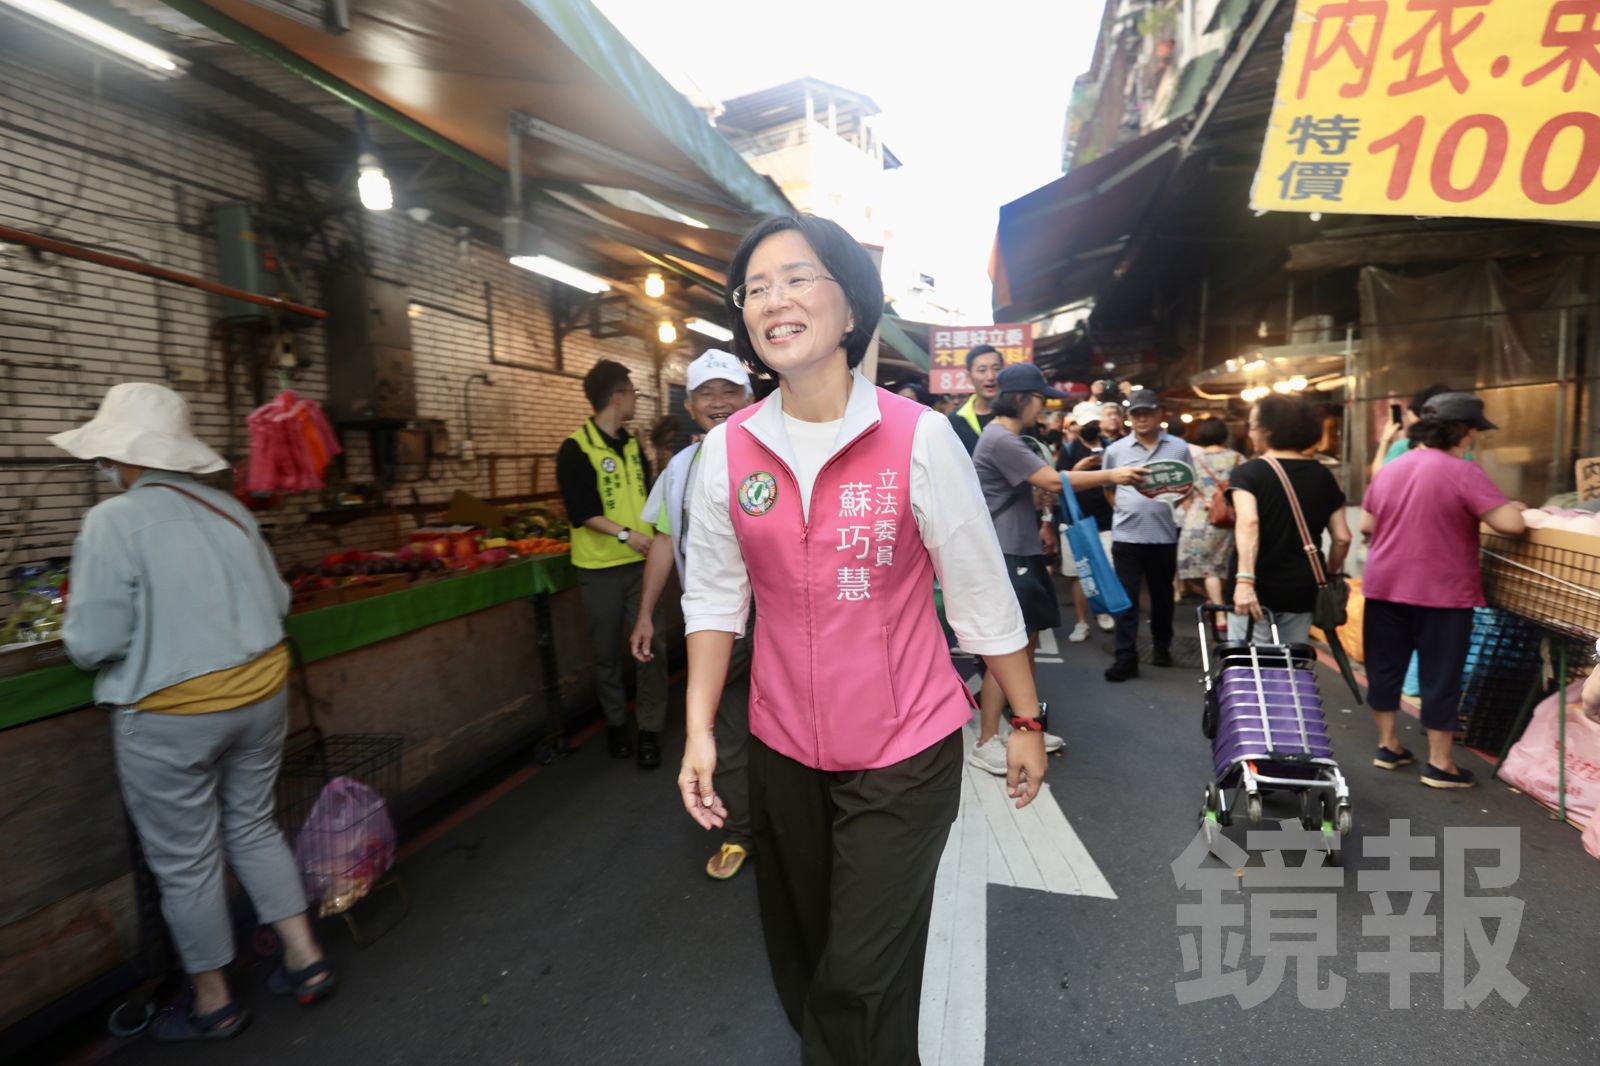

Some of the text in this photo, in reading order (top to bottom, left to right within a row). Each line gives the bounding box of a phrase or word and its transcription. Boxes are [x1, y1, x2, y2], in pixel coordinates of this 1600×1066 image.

[1277, 114, 1360, 202] 特價
[1367, 111, 1600, 205] 100
[935, 329, 1023, 348] 只要好立委
[836, 482, 872, 601] 蘇巧慧
[874, 468, 898, 567] 立法委員
